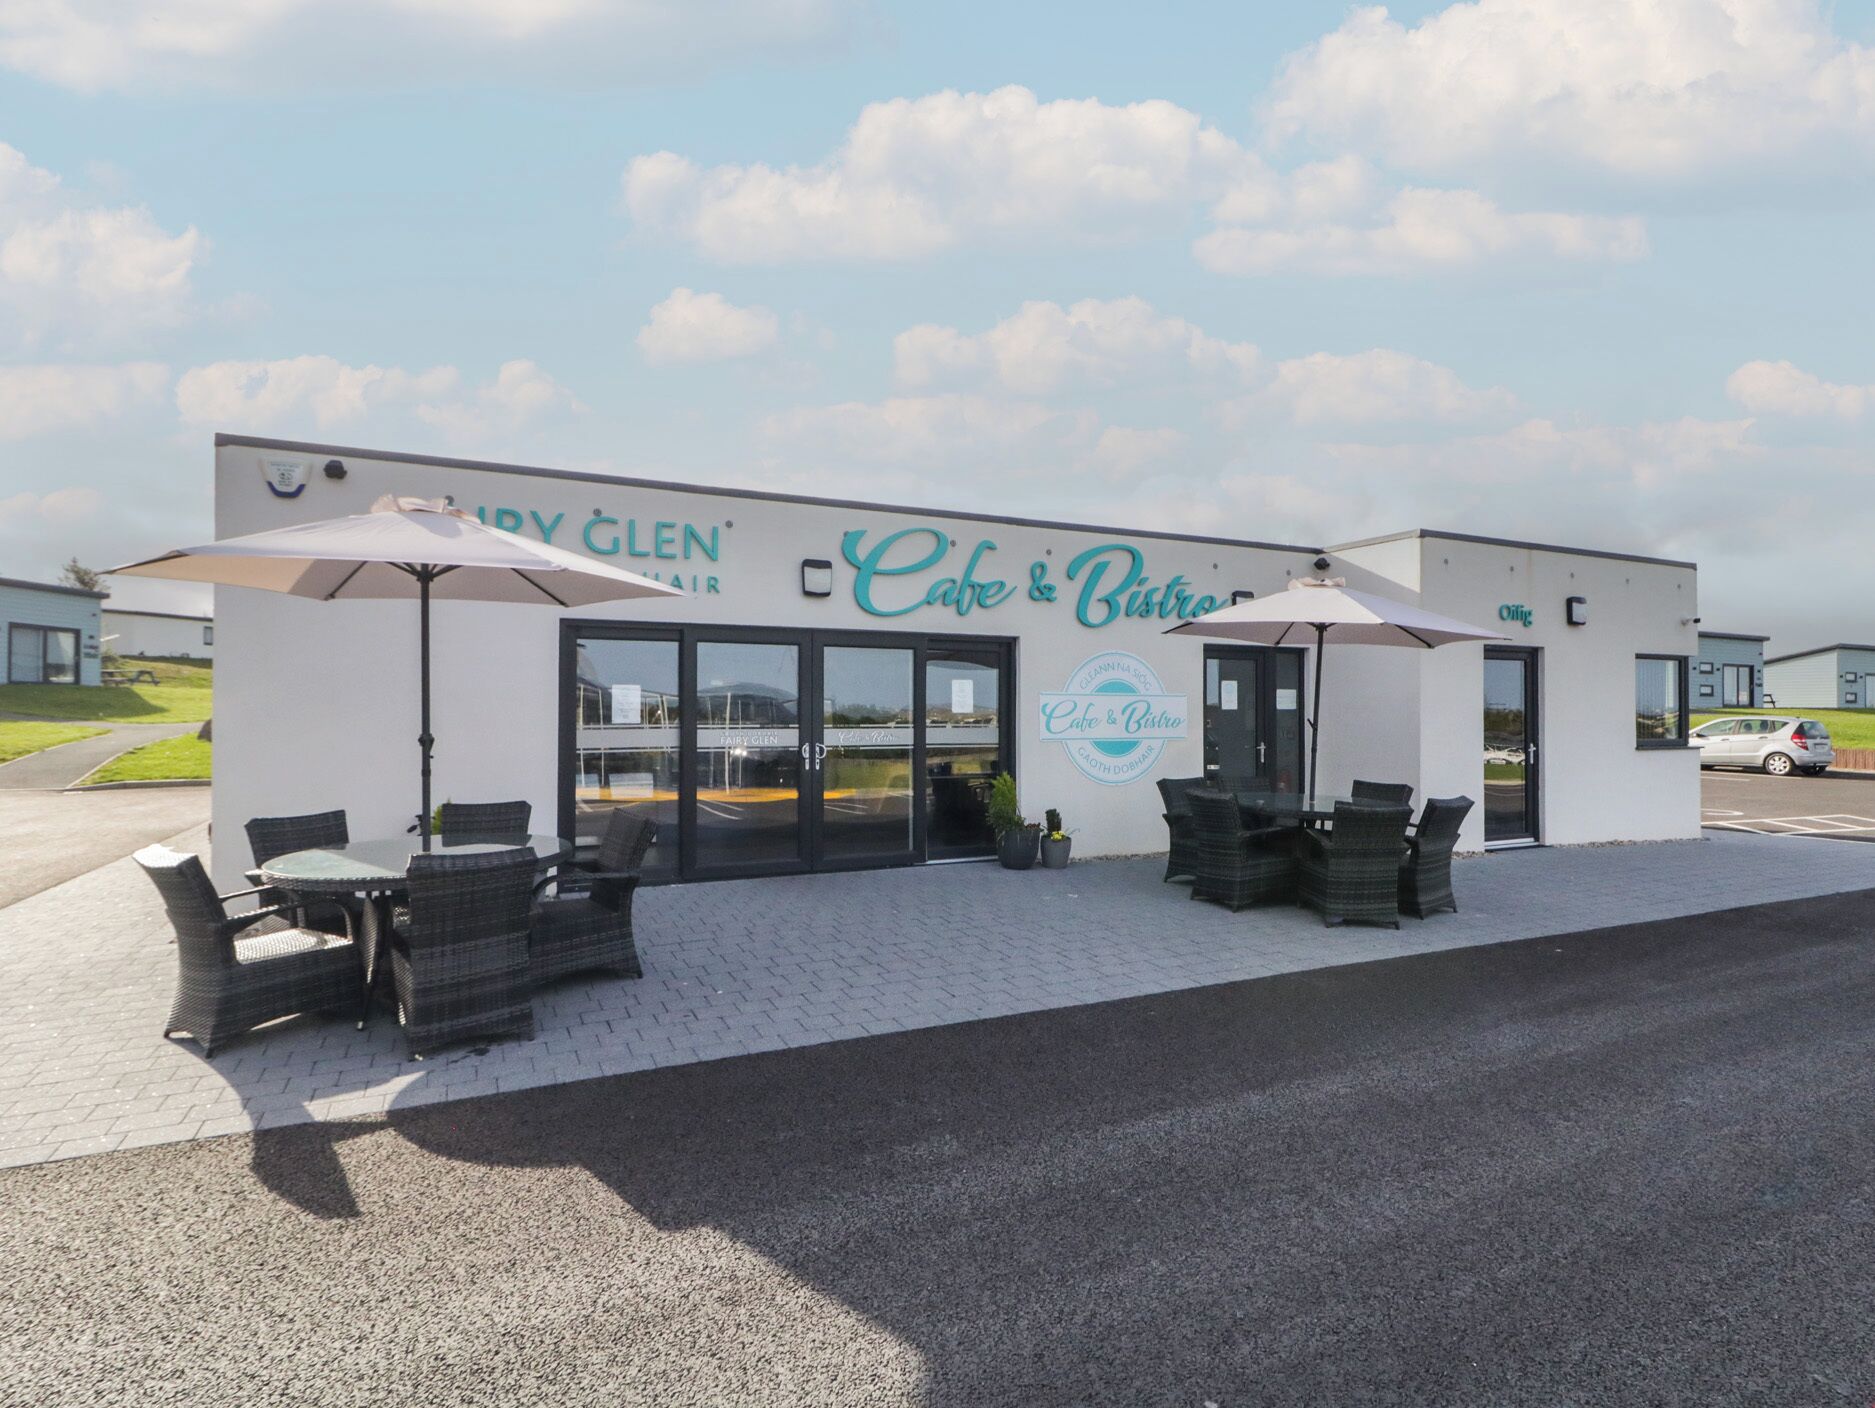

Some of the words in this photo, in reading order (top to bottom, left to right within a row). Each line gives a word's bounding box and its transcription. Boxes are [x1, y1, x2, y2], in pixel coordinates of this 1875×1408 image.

[583, 515, 719, 561] GLEN
[841, 527, 1018, 617] Cafe
[1028, 560, 1058, 602] &
[1067, 543, 1229, 628] Bistro
[1498, 604, 1533, 628] Oifig
[1079, 662, 1115, 690] GLEANN
[1116, 662, 1131, 675] NA
[1041, 700, 1101, 735] Cafe
[1106, 709, 1118, 725] &
[1121, 700, 1186, 735] Bistro
[720, 735, 748, 745] FAIRY
[751, 735, 778, 745] GLEN
[1078, 747, 1111, 774] GAOTH
[1113, 744, 1155, 775] DOBHAIR
